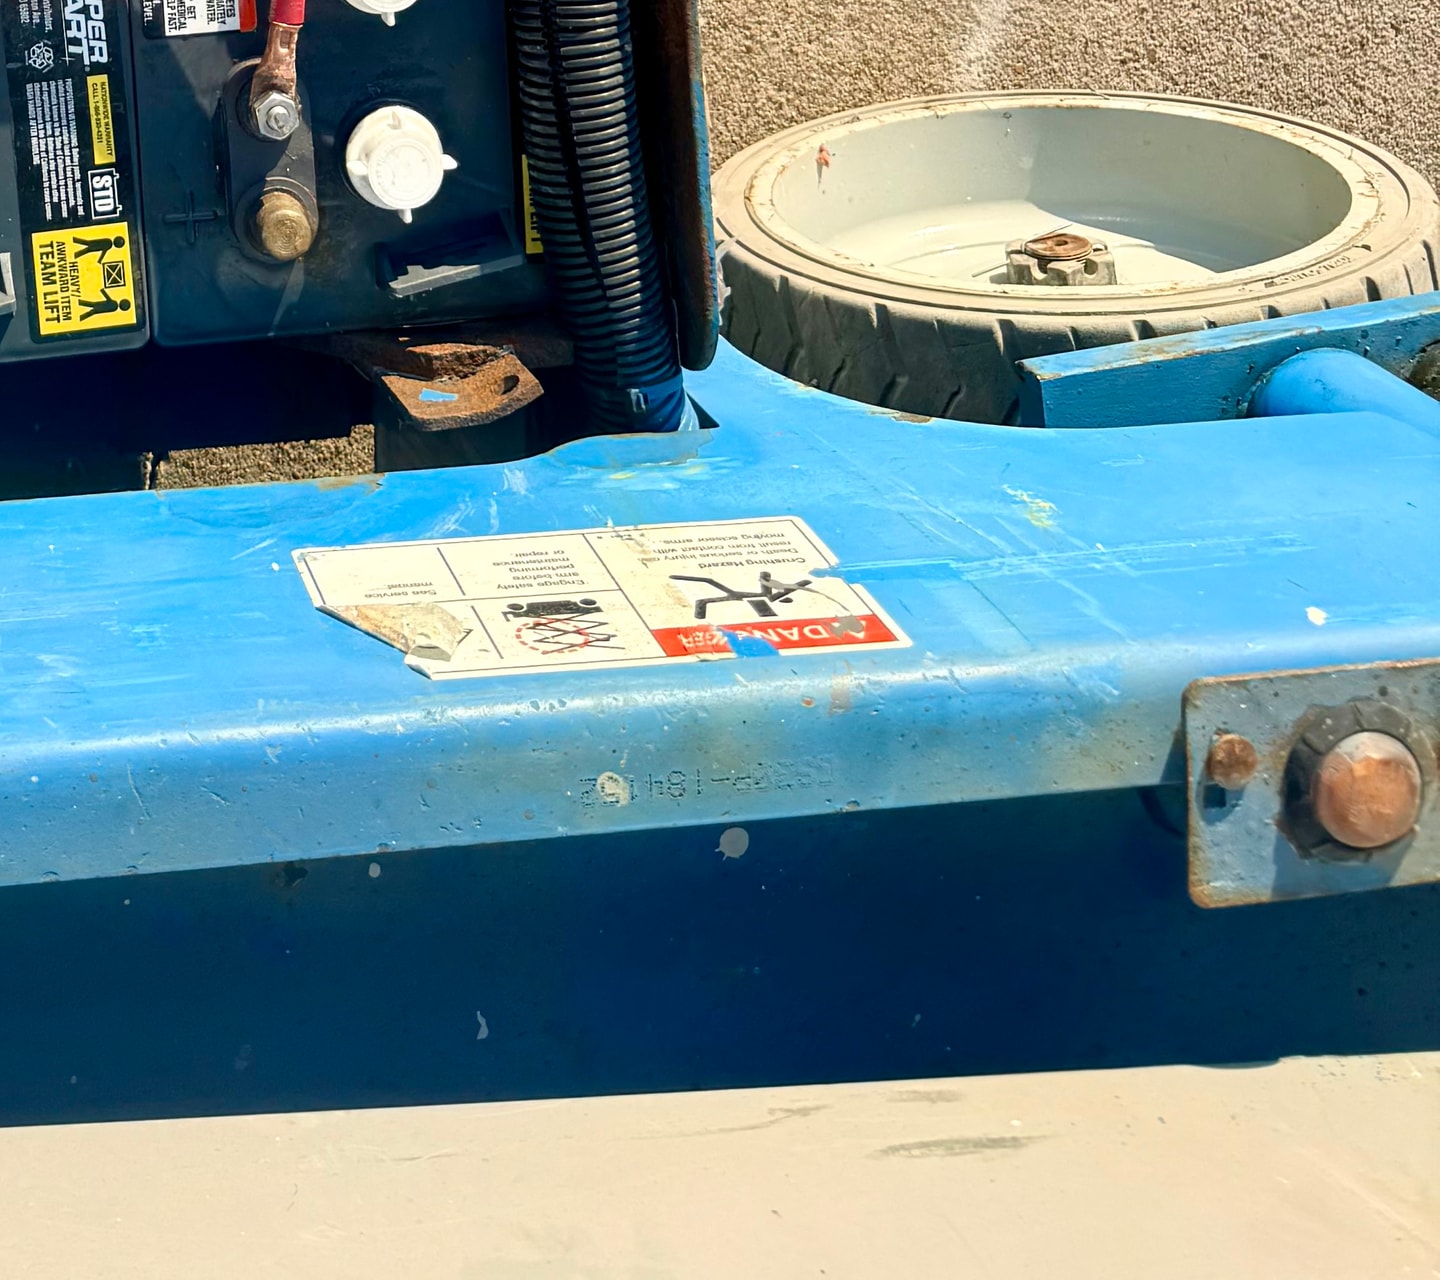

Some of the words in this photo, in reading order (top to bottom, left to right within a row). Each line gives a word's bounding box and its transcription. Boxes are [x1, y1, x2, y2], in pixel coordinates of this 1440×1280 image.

[187, 5, 196, 19] GET
[226, 0, 236, 18] EYES
[92, 175, 113, 211] STD
[40, 241, 57, 288] TEAM
[56, 241, 71, 292] AWKWARD
[68, 261, 81, 297] HEAVY/
[43, 291, 60, 324] LIFT
[61, 296, 72, 320] ITEM
[741, 532, 785, 540] moving
[492, 556, 570, 567] maintenance
[509, 562, 575, 574] performing
[698, 560, 737, 569] Hazard
[740, 557, 806, 567] Crushing
[496, 581, 533, 591] safety
[537, 579, 585, 589] Engage
[364, 590, 409, 600] service
